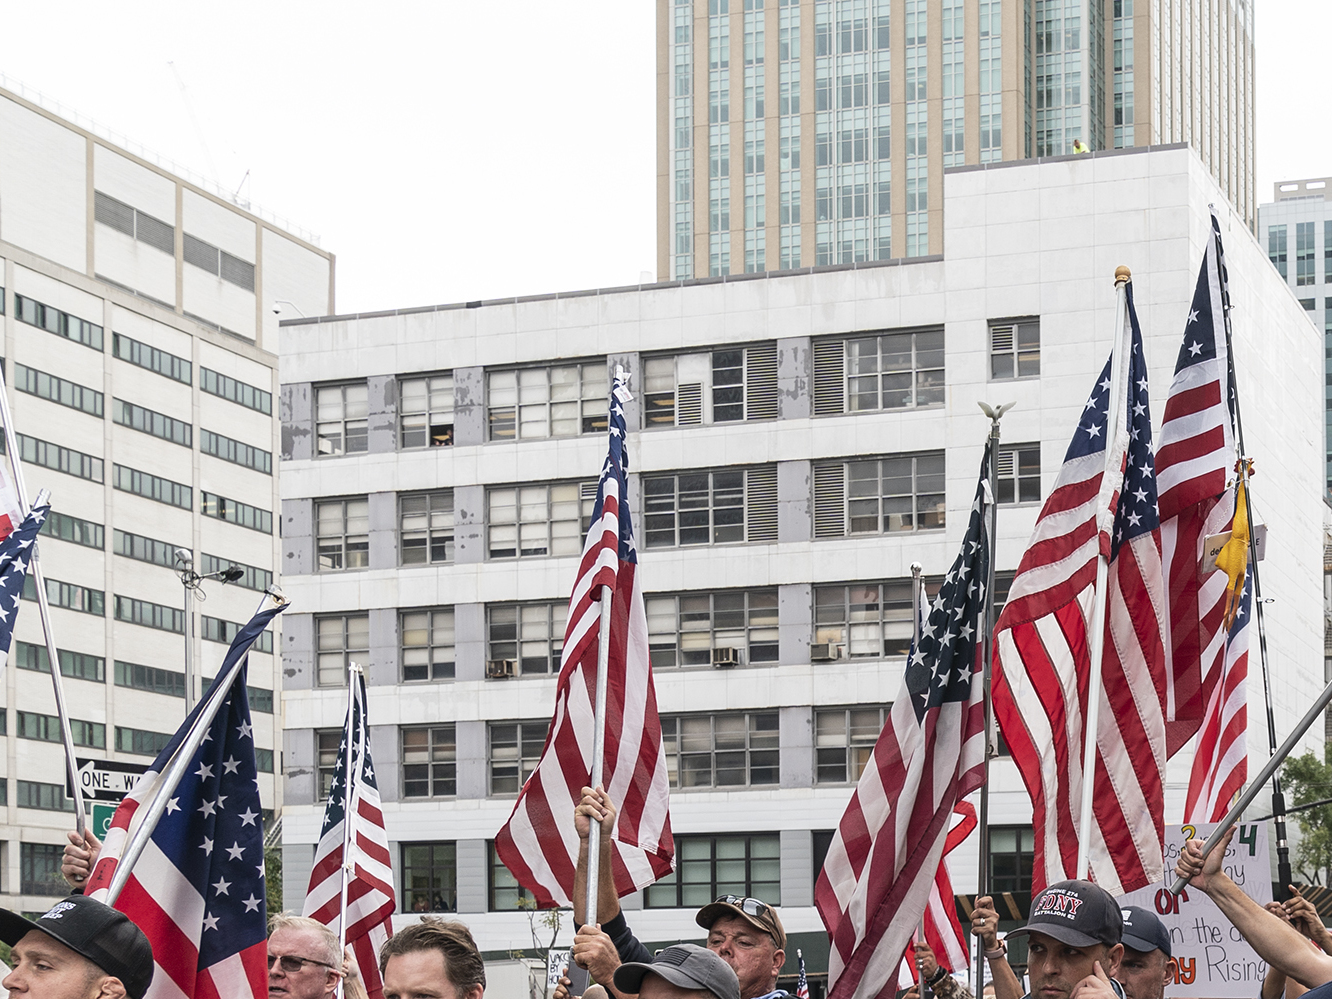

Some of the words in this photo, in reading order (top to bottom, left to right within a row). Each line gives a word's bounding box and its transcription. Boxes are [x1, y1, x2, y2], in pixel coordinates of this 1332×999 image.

[82, 771, 110, 788] ONE
[1239, 825, 1258, 857] 4
[1034, 894, 1083, 915] FDNY
[1034, 910, 1067, 918] BATTALION
[1192, 917, 1223, 944] the
[1205, 945, 1268, 983] Rising
